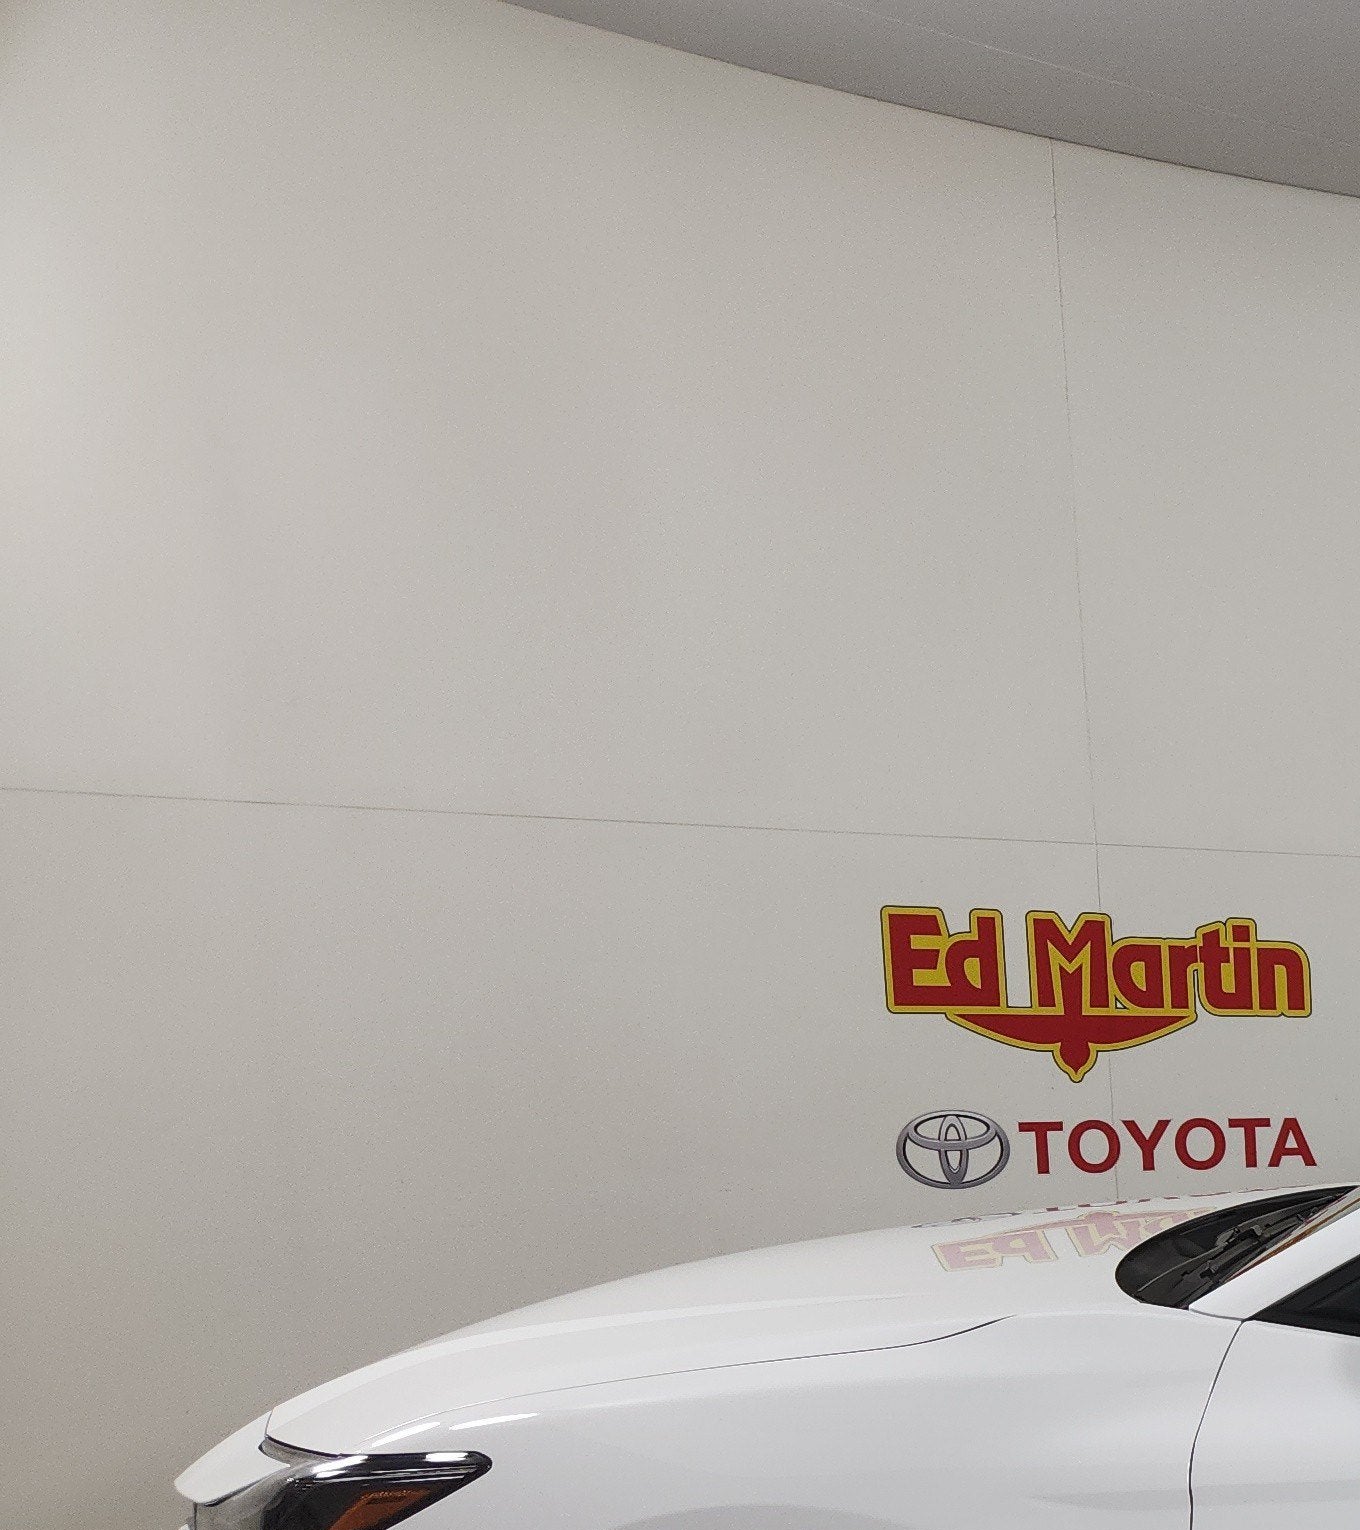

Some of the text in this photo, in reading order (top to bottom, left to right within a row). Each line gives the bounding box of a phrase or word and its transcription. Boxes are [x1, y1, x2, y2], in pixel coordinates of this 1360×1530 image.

[880, 905, 1312, 1018] Ed Martin
[1019, 1116, 1317, 1175] TOYOTA
